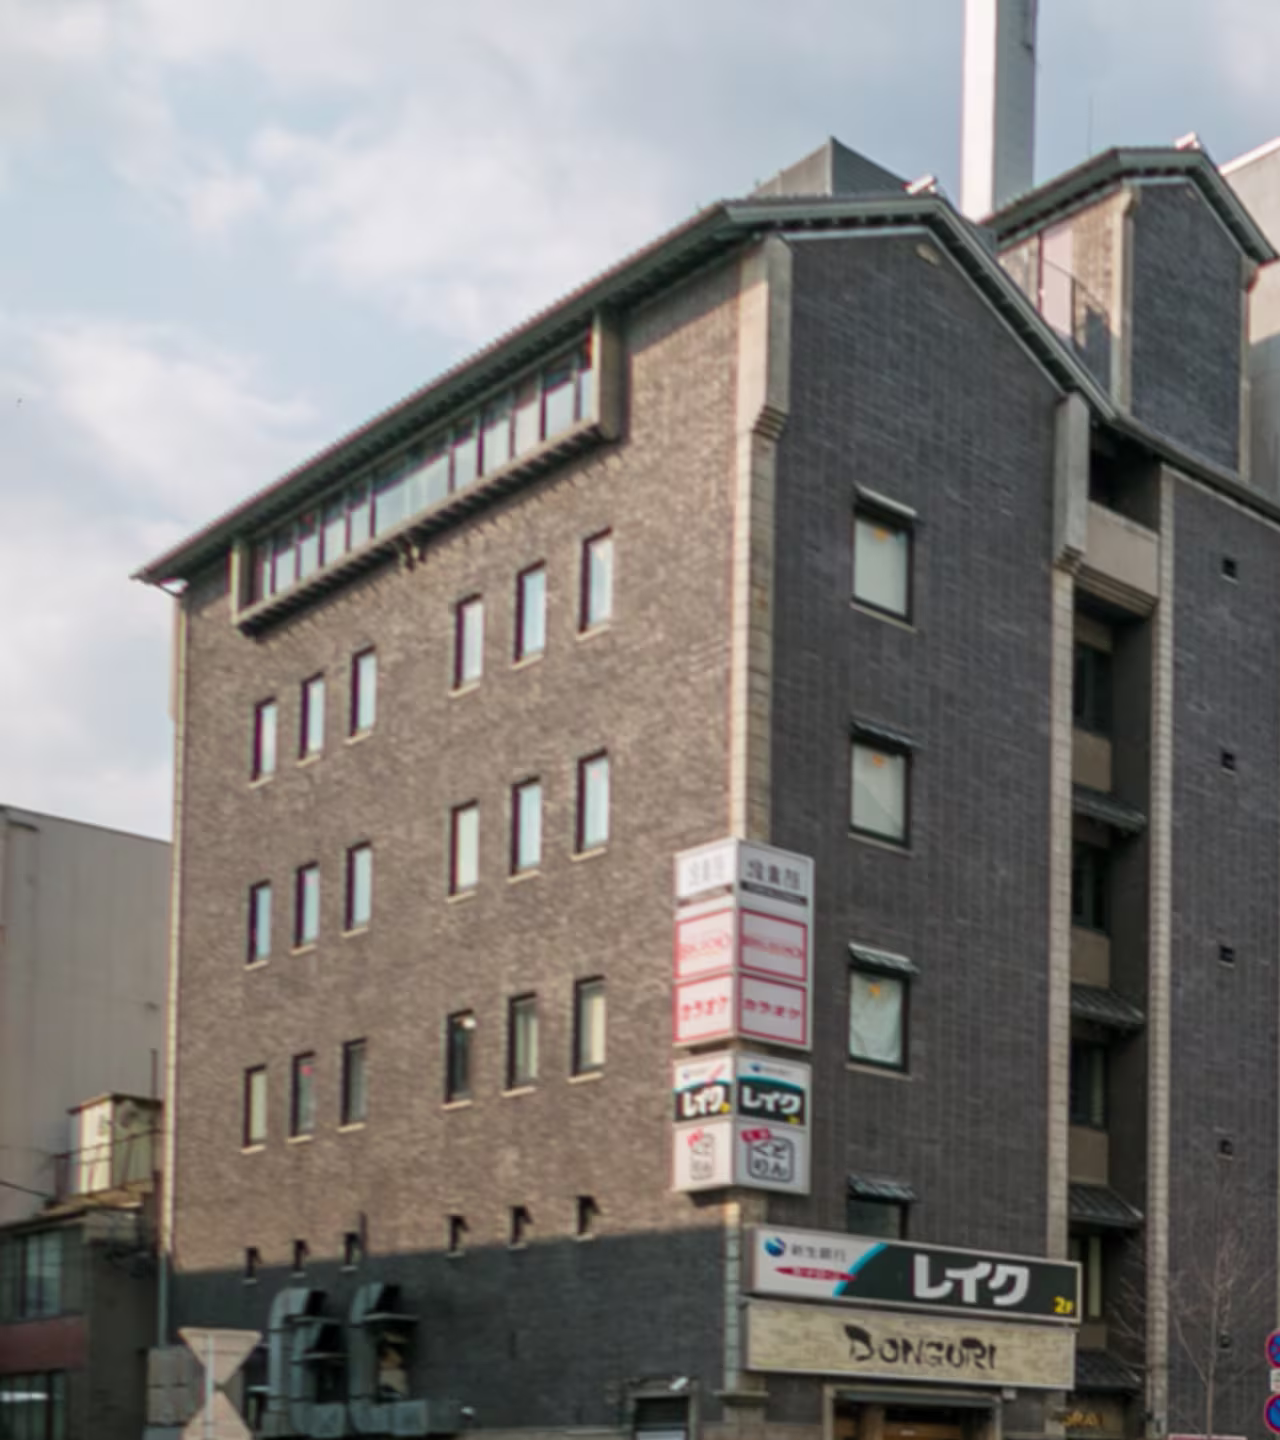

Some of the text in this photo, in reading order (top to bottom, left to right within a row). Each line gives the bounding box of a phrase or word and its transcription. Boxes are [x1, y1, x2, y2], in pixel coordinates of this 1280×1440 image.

[742, 1086, 801, 1115] レイク
[913, 1254, 1030, 1306] レイク
[843, 1323, 998, 1370] DONGURI
